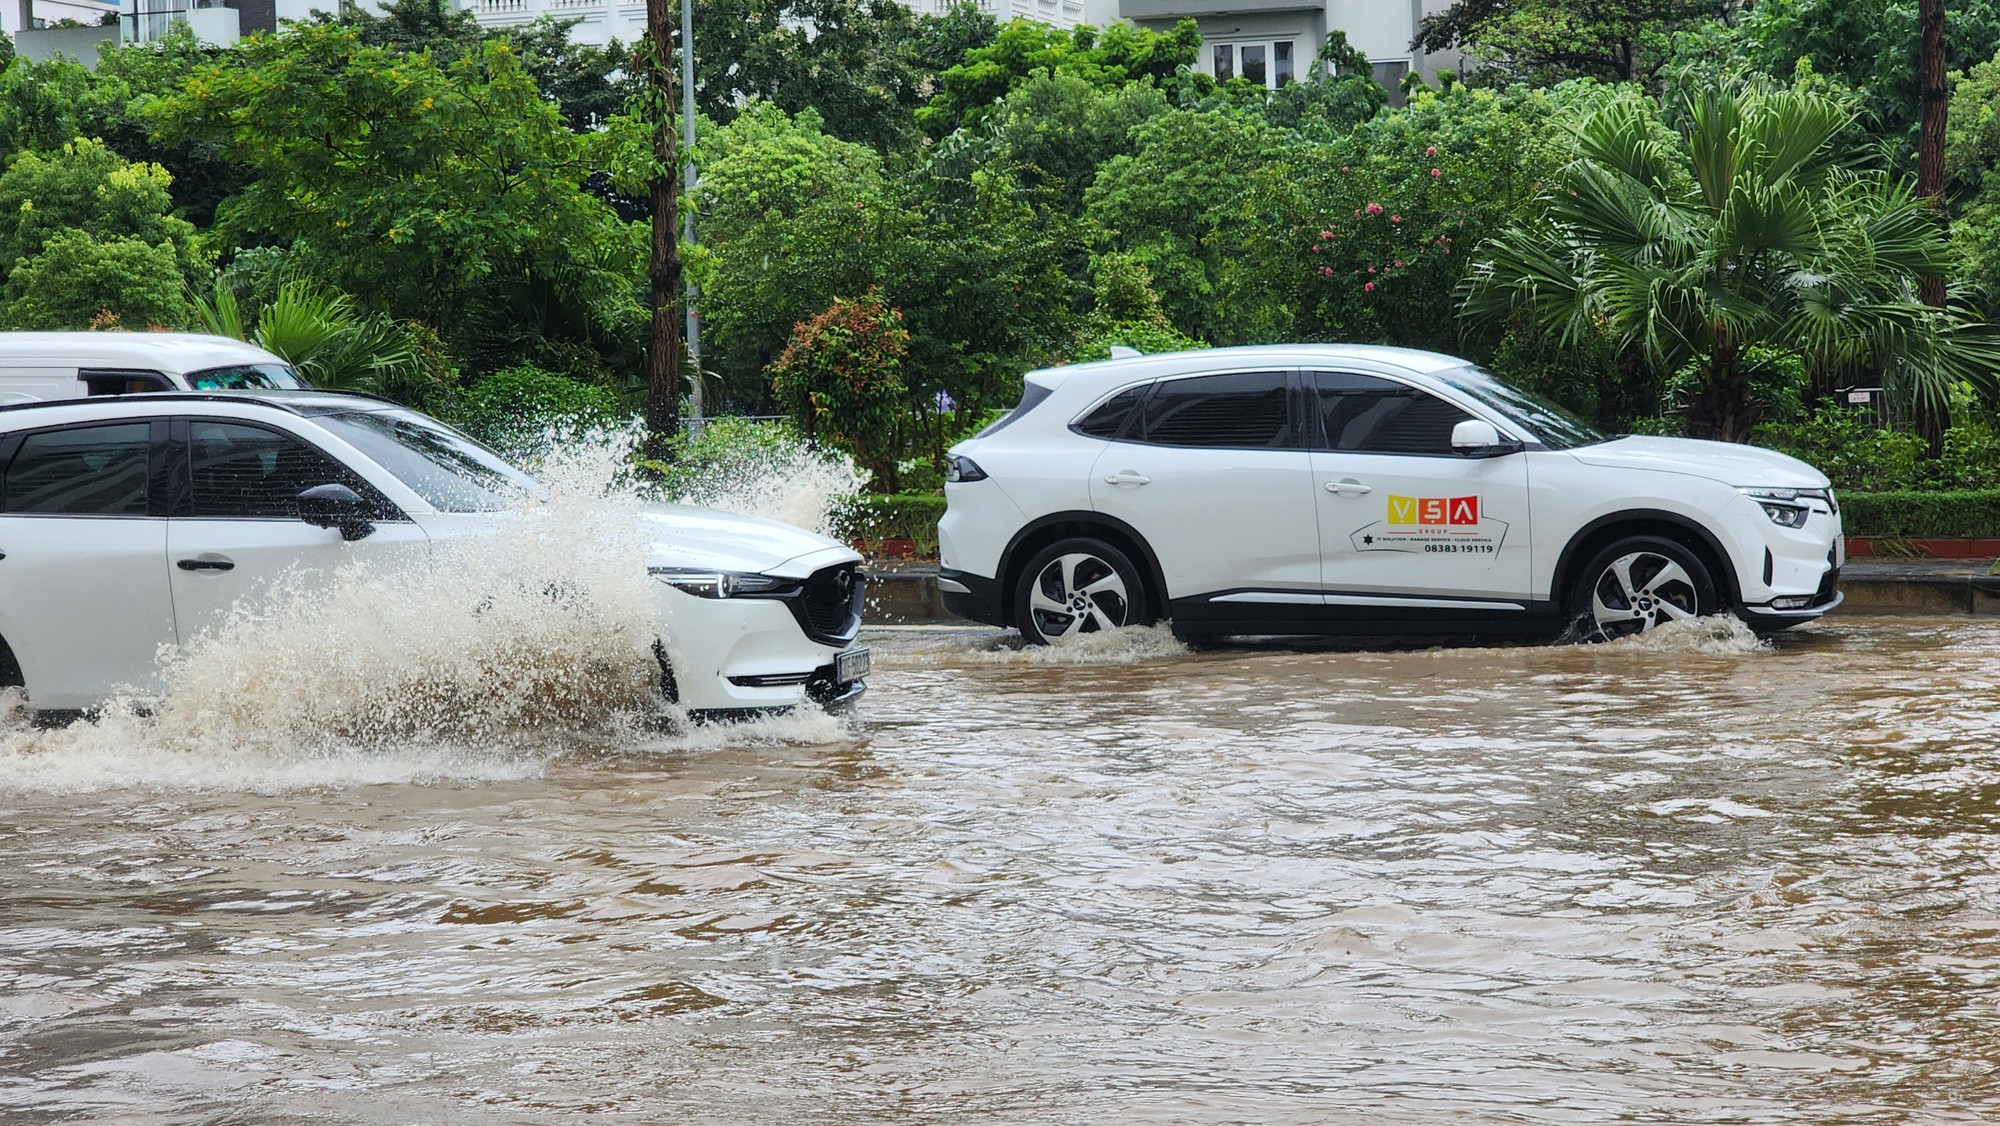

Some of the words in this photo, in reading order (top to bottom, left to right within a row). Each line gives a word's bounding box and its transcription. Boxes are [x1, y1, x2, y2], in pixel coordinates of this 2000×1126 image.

[1392, 500, 1474, 524] VSA
[1424, 544, 1458, 553] 08383
[1460, 545, 1493, 553] 19119
